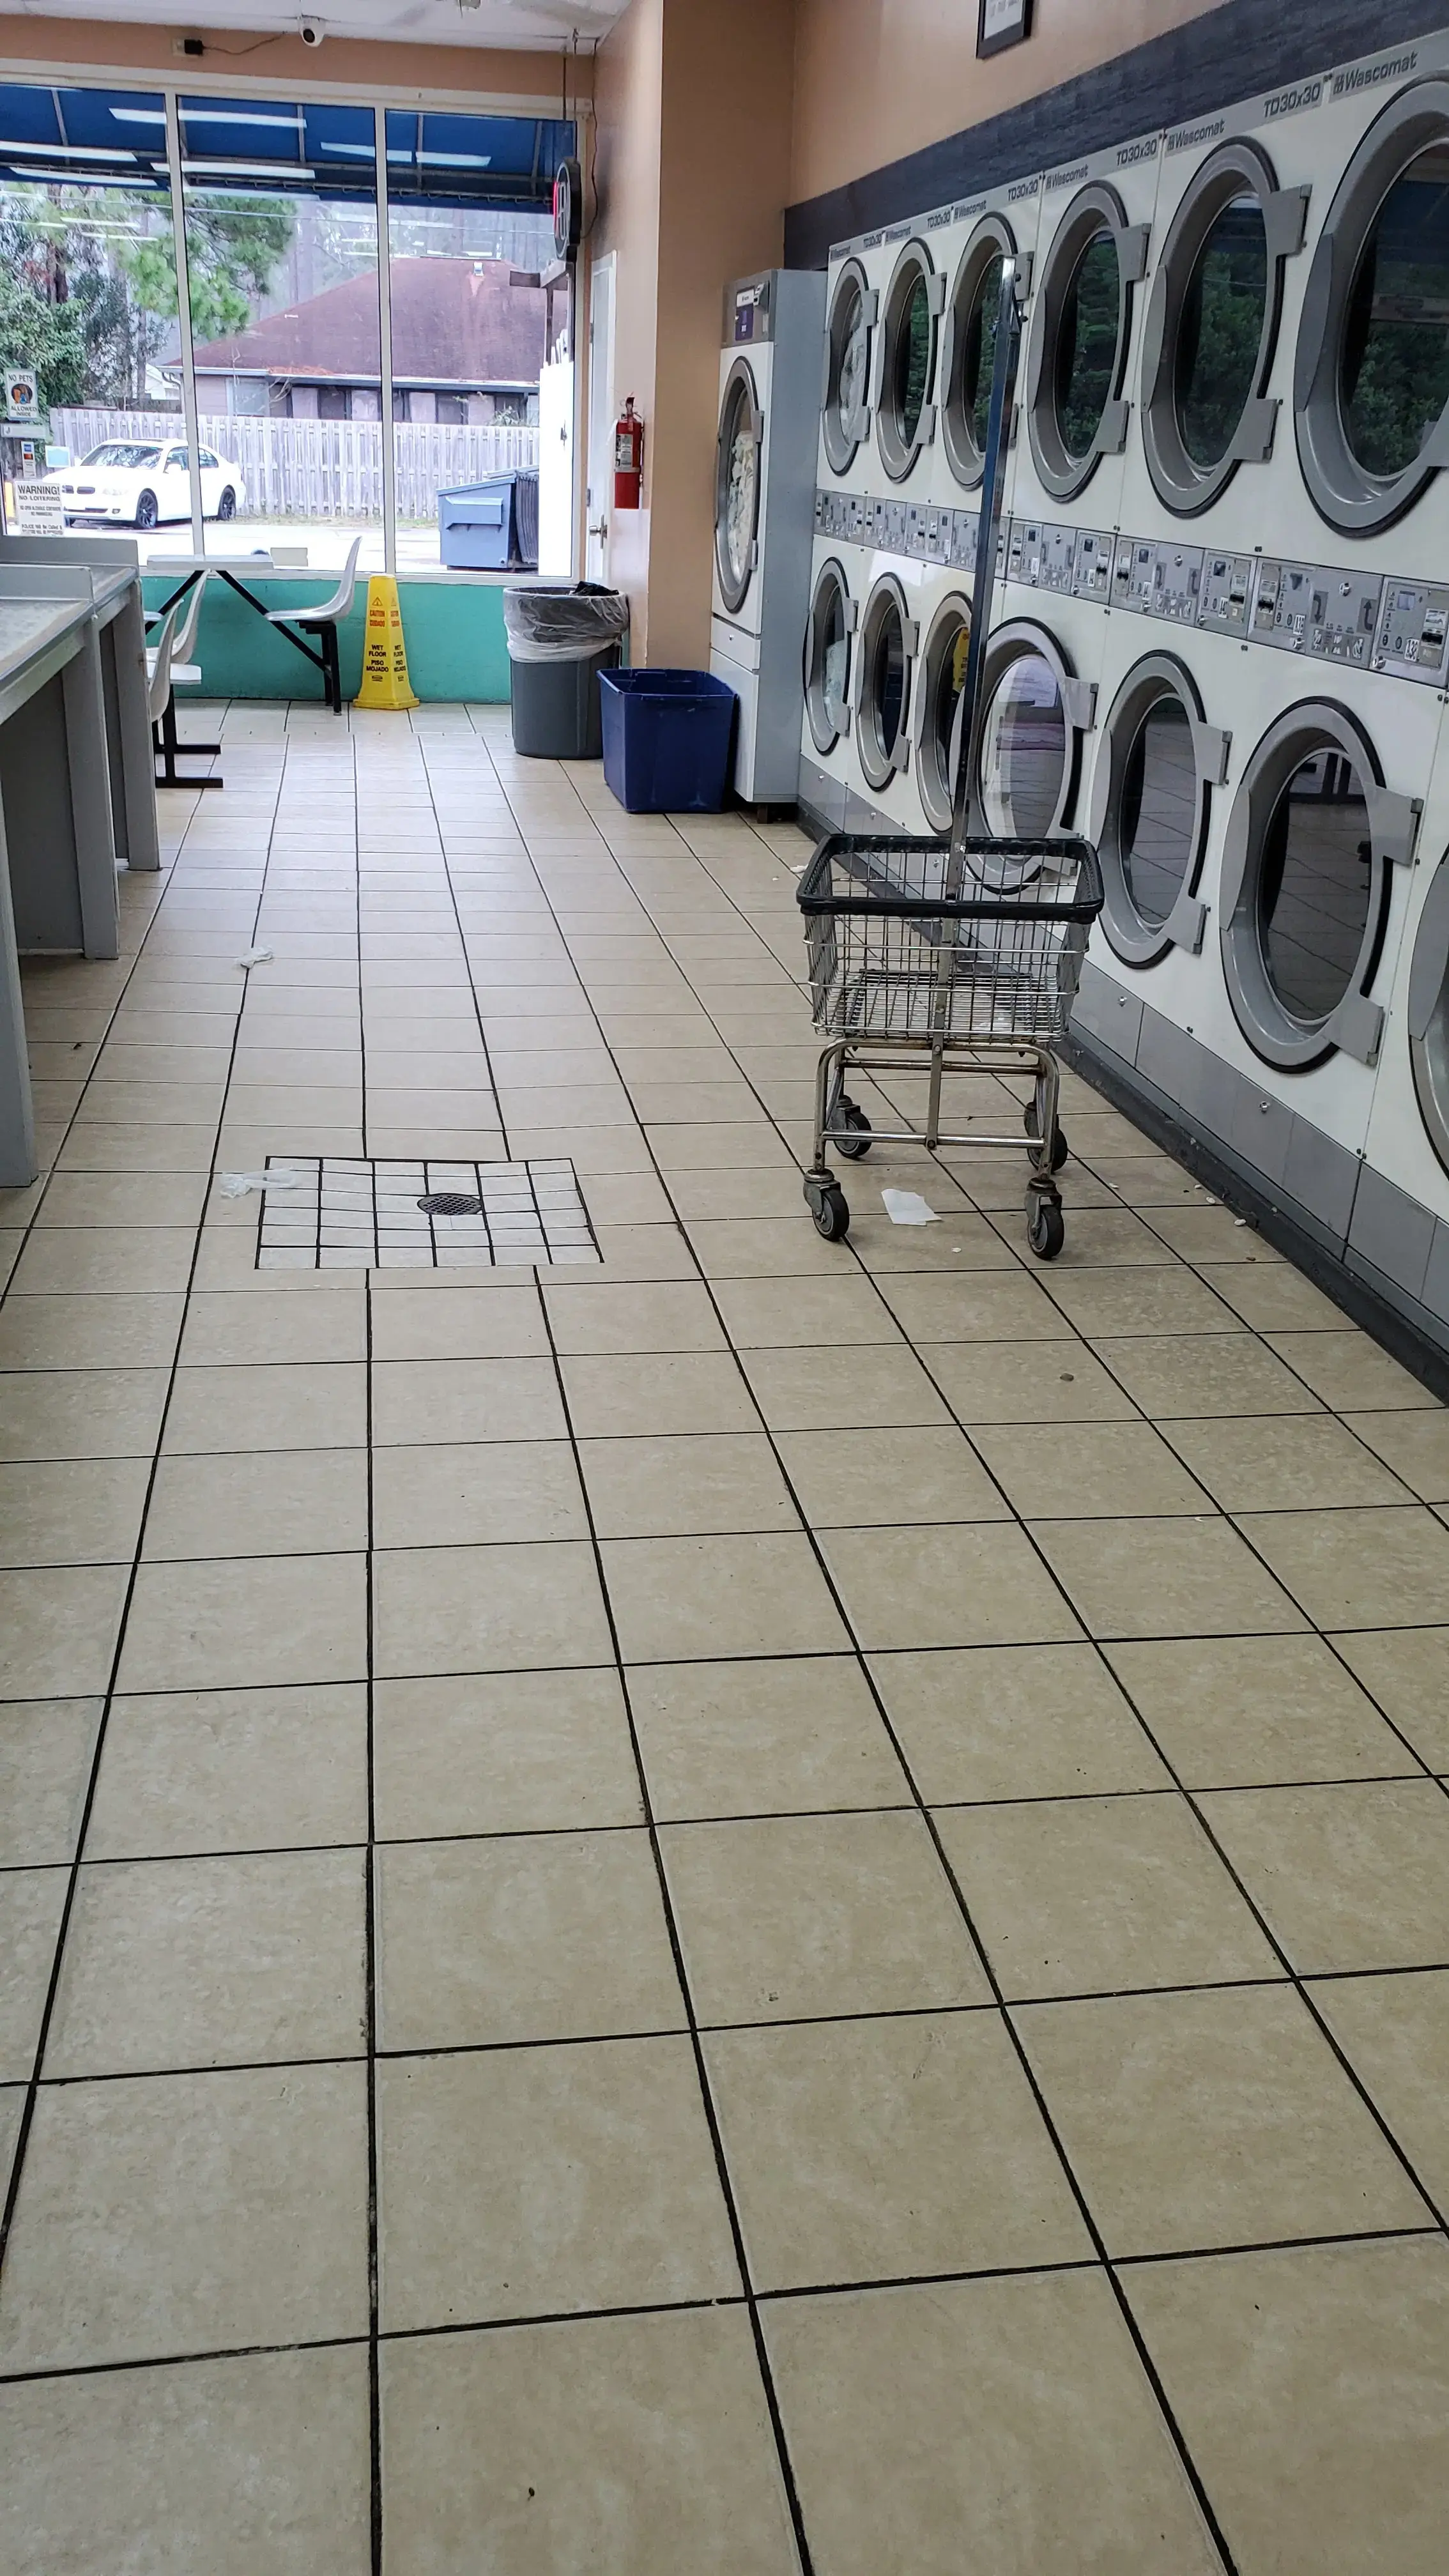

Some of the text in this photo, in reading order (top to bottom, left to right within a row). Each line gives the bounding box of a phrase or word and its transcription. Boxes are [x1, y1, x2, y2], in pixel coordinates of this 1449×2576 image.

[1346, 50, 1418, 91] Wascomat
[1174, 82, 1321, 148] Wascomat TD30x30
[1052, 139, 1158, 189] Wascomat TD30x30
[1008, 178, 1038, 201] TD30x30
[8, 374, 33, 383] NO PETS
[18, 484, 61, 496] WARNING!
